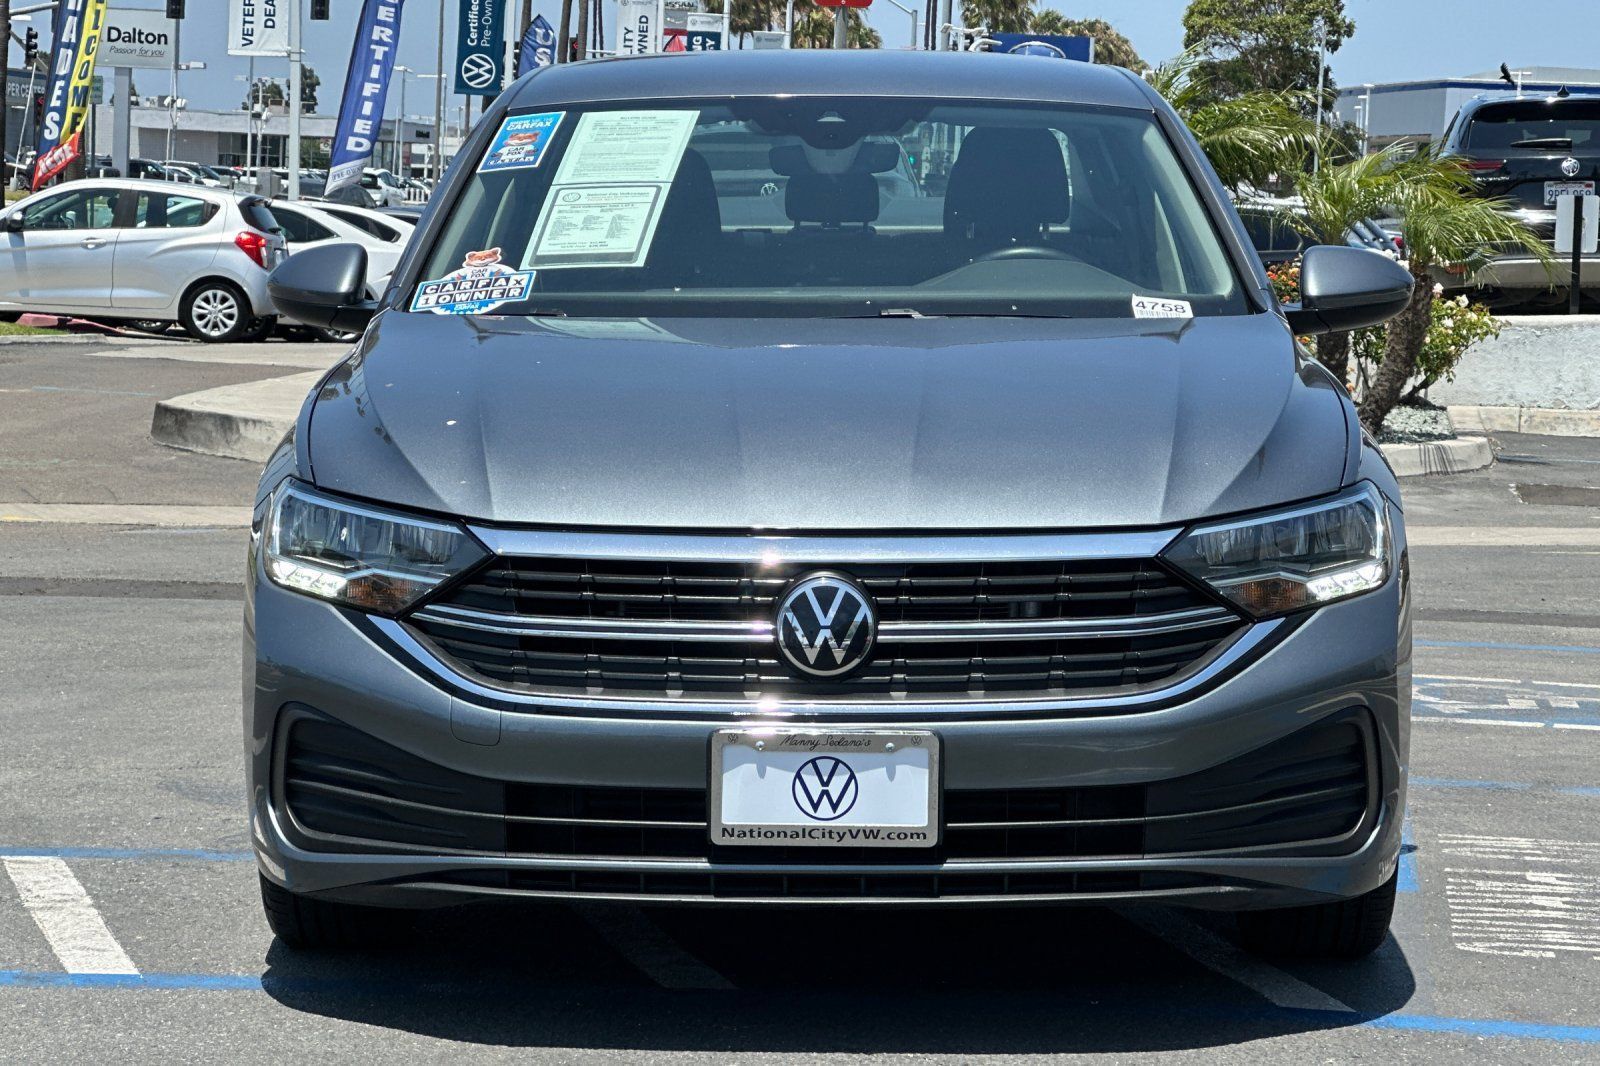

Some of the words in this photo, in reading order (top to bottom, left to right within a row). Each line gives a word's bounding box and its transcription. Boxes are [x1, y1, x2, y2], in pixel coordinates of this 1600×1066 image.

[106, 26, 168, 45] Dalton
[623, 26, 634, 55] ITY
[109, 45, 137, 55] Passion
[138, 46, 149, 56] for
[150, 49, 165, 57] you
[69, 0, 105, 134] LCOME
[345, 0, 400, 153] ERTIFIED
[506, 120, 552, 131] CARFAX
[332, 164, 366, 181] PRE-OWN
[425, 277, 525, 294] CARFAX
[438, 287, 522, 304] OWNER
[1135, 300, 1186, 313] 4758
[776, 577, 876, 676] VW
[780, 734, 821, 751] Manny
[791, 755, 859, 821] VW
[721, 827, 928, 842] NationalCityVW.com
